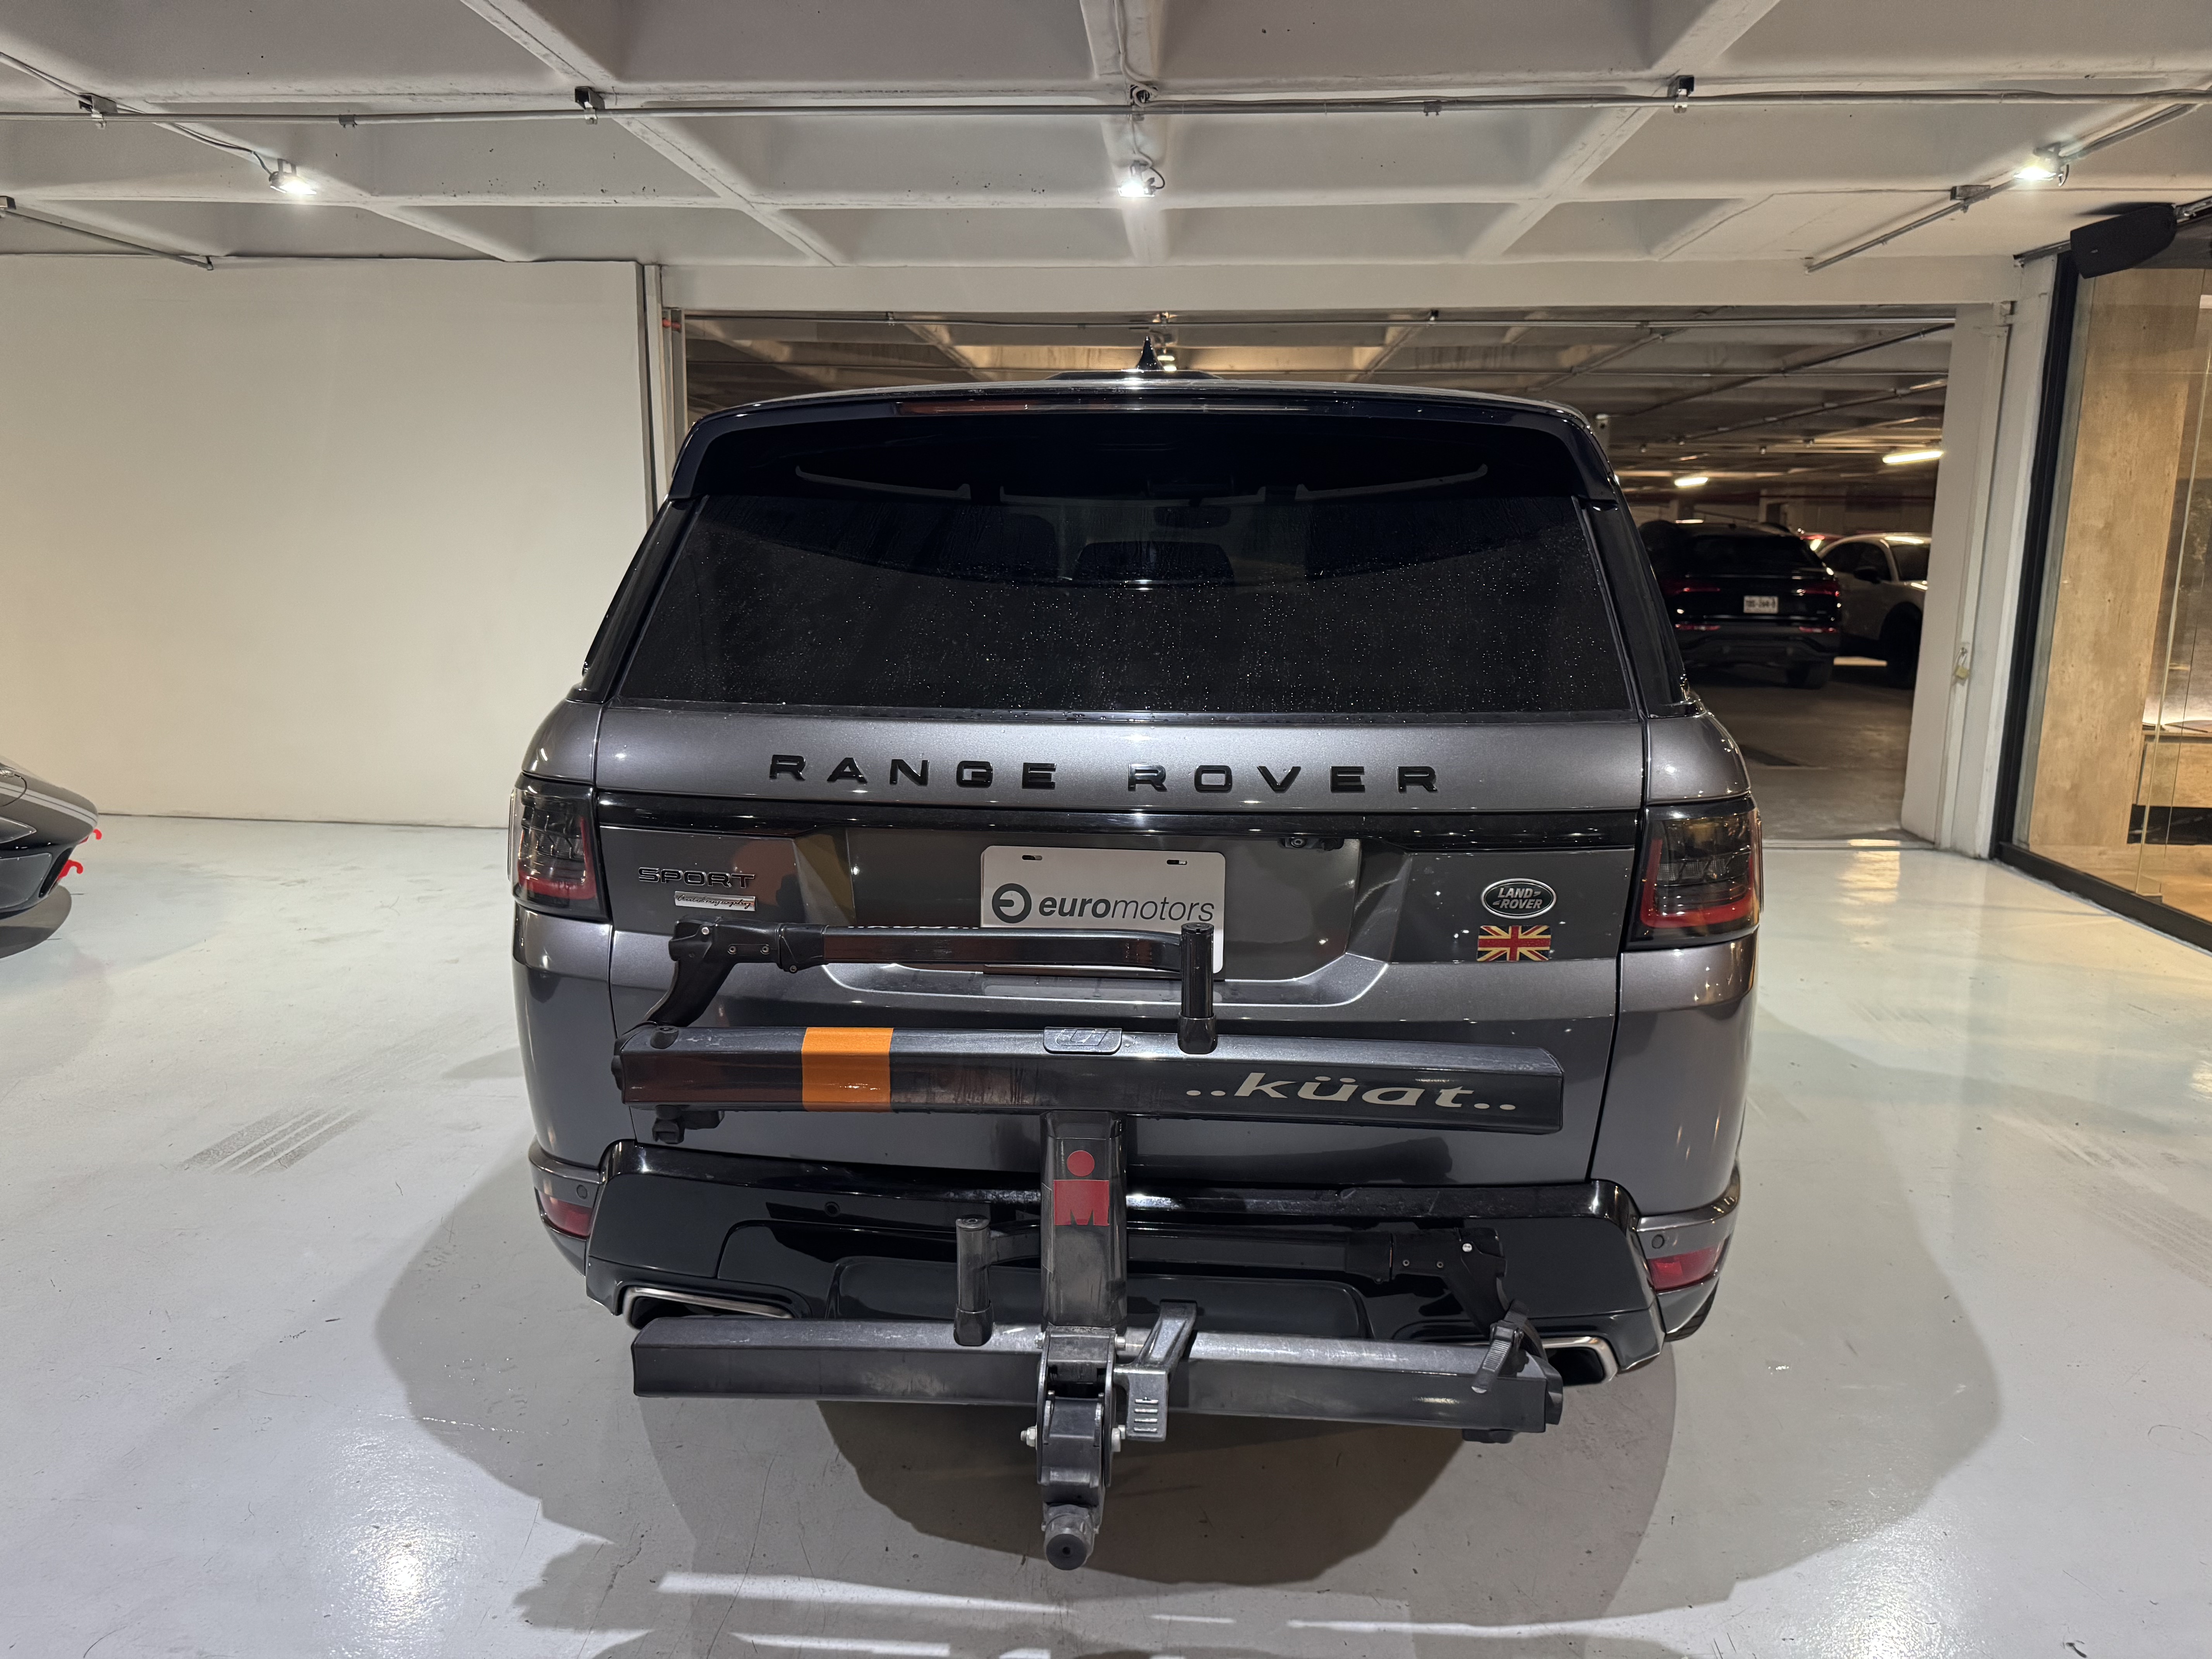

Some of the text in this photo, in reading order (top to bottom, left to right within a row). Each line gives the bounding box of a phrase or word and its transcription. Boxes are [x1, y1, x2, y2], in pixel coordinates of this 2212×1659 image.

[769, 754, 1438, 793] RANGE ROVER
[639, 867, 756, 888] SPORT
[1498, 888, 1533, 898] LAND
[677, 895, 752, 909] Autobiography
[1039, 896, 1215, 922] euromotors
[1499, 899, 1543, 909] ROVER
